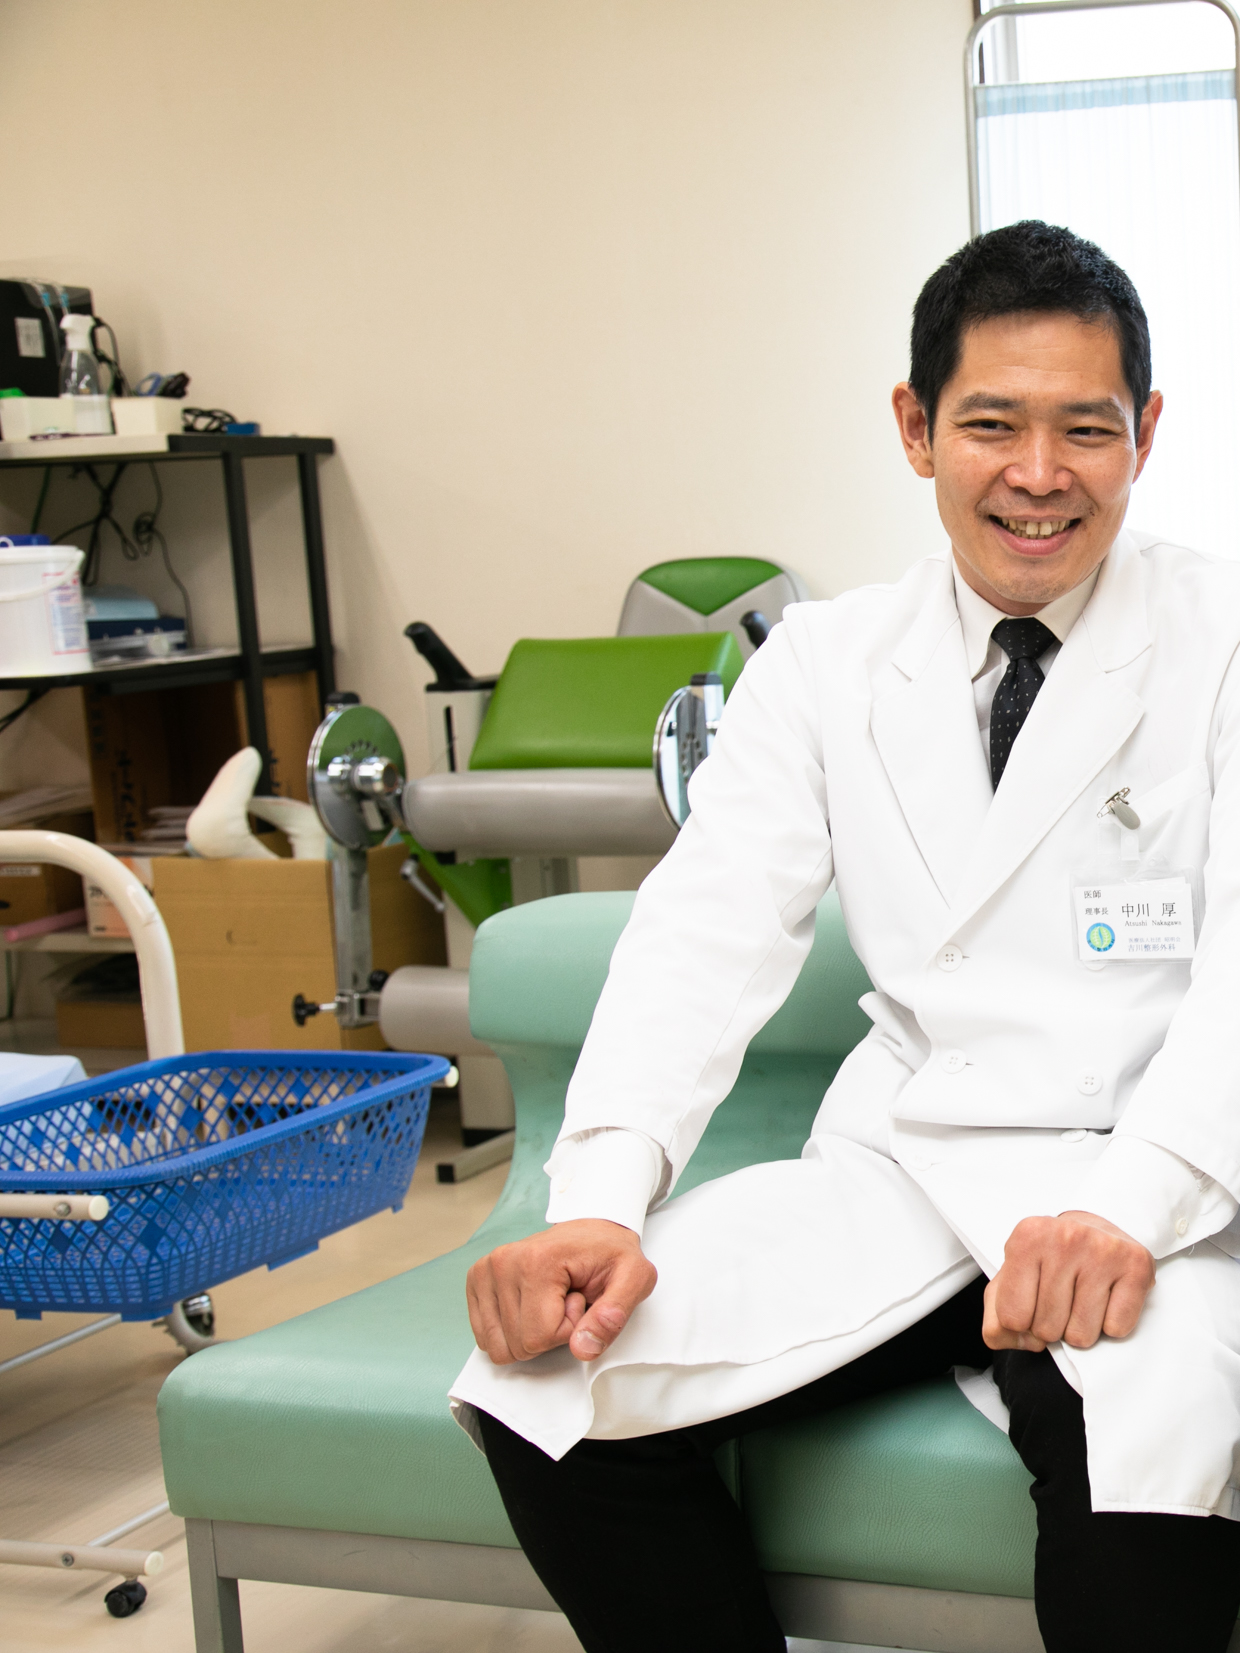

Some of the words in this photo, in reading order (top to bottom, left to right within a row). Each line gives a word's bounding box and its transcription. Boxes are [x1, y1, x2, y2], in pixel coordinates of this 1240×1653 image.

[1084, 889, 1102, 899] 医師
[1084, 907, 1109, 916] 理事長
[1121, 903, 1150, 918] 中川
[1161, 902, 1177, 917] 厚
